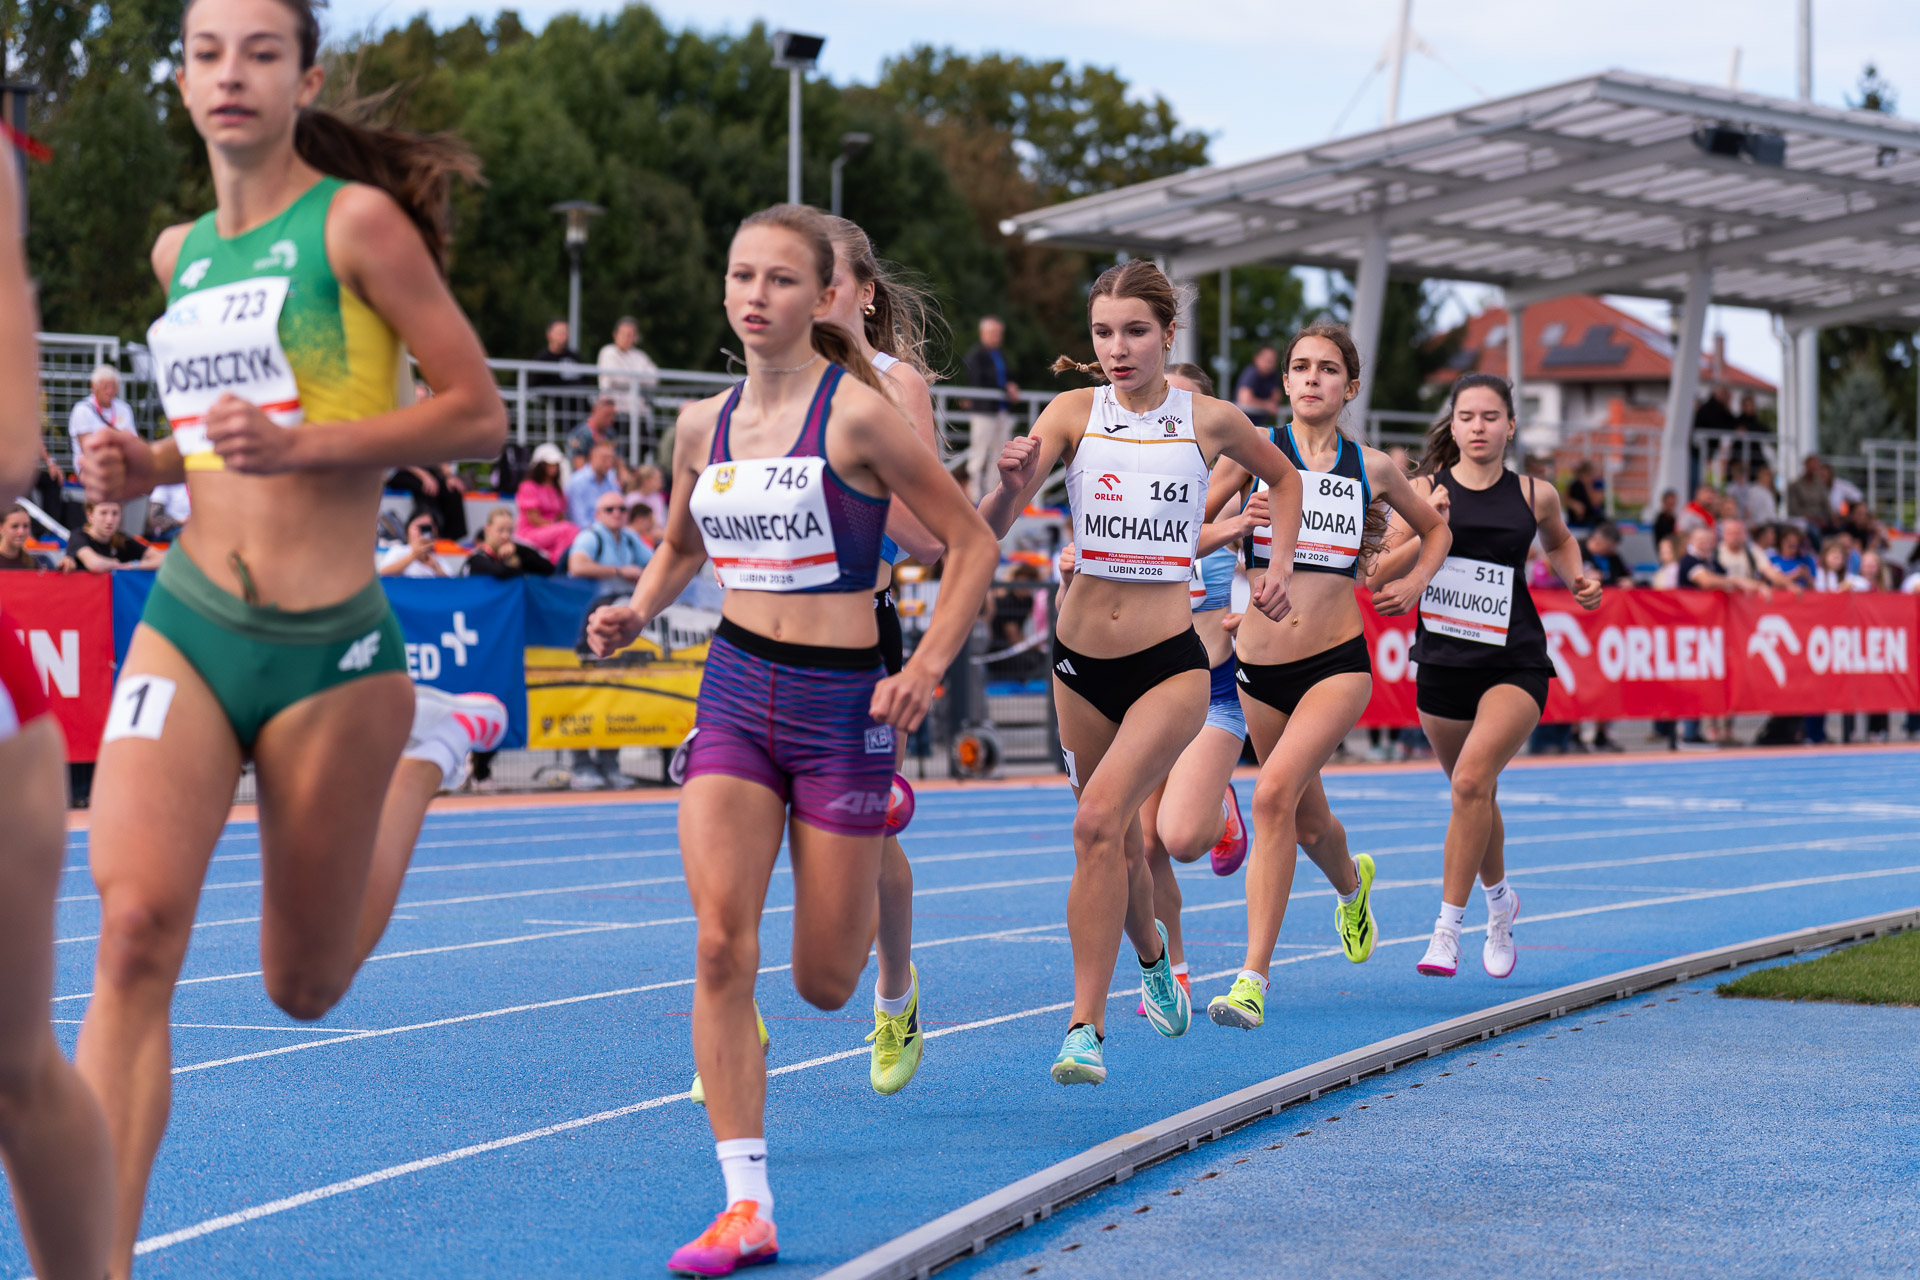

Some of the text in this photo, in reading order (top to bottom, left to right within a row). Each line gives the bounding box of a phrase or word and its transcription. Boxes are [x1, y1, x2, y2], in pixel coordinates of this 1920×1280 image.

[220, 288, 267, 325] 723
[764, 465, 809, 491] 746
[1318, 478, 1355, 501] 864
[1094, 492, 1123, 502] ORLEN
[1150, 480, 1189, 503] 161
[701, 510, 824, 542] GLINIECKA
[1085, 513, 1190, 543] MICHALAK
[1308, 553, 1329, 562] 2026
[739, 573, 795, 585] LUBIN 2026
[1108, 565, 1163, 576] LUBIN 2026
[1474, 566, 1506, 586] 511
[1425, 585, 1508, 617] PAWLUKOJĆ
[1441, 624, 1481, 639] LUBIN 2026
[1598, 625, 1726, 682] ORLEN
[1807, 625, 1908, 675] ORLEN
[127, 682, 152, 728] 1
